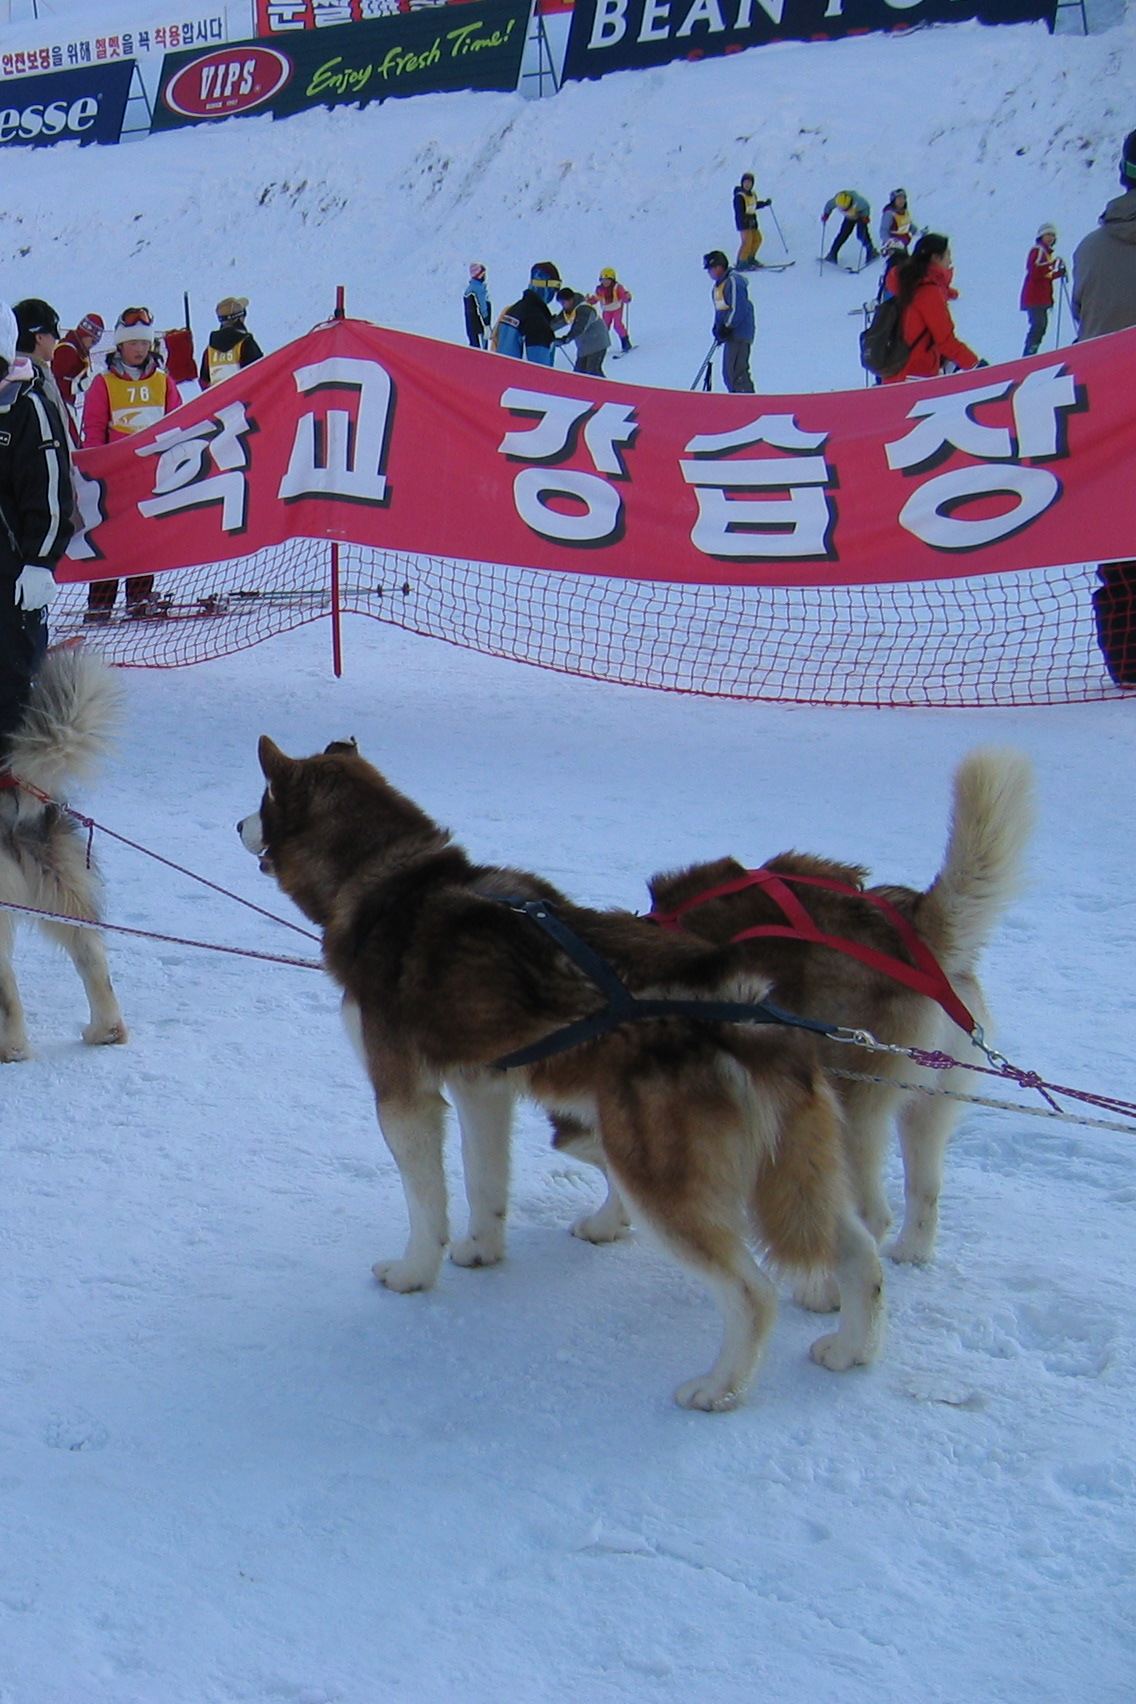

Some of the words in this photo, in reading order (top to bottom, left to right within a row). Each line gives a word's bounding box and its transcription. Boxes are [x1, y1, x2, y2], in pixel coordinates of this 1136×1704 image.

[67, 38, 92, 63] 위해
[95, 33, 134, 60] 헬멧을
[138, 31, 151, 51] 꼭
[154, 17, 223, 48] 착용합시다
[306, 57, 372, 96] Enjoy
[447, 19, 516, 57] Time!
[199, 58, 256, 100] VIPS
[126, 386, 151, 404] 76
[498, 362, 1077, 557] 강습장
